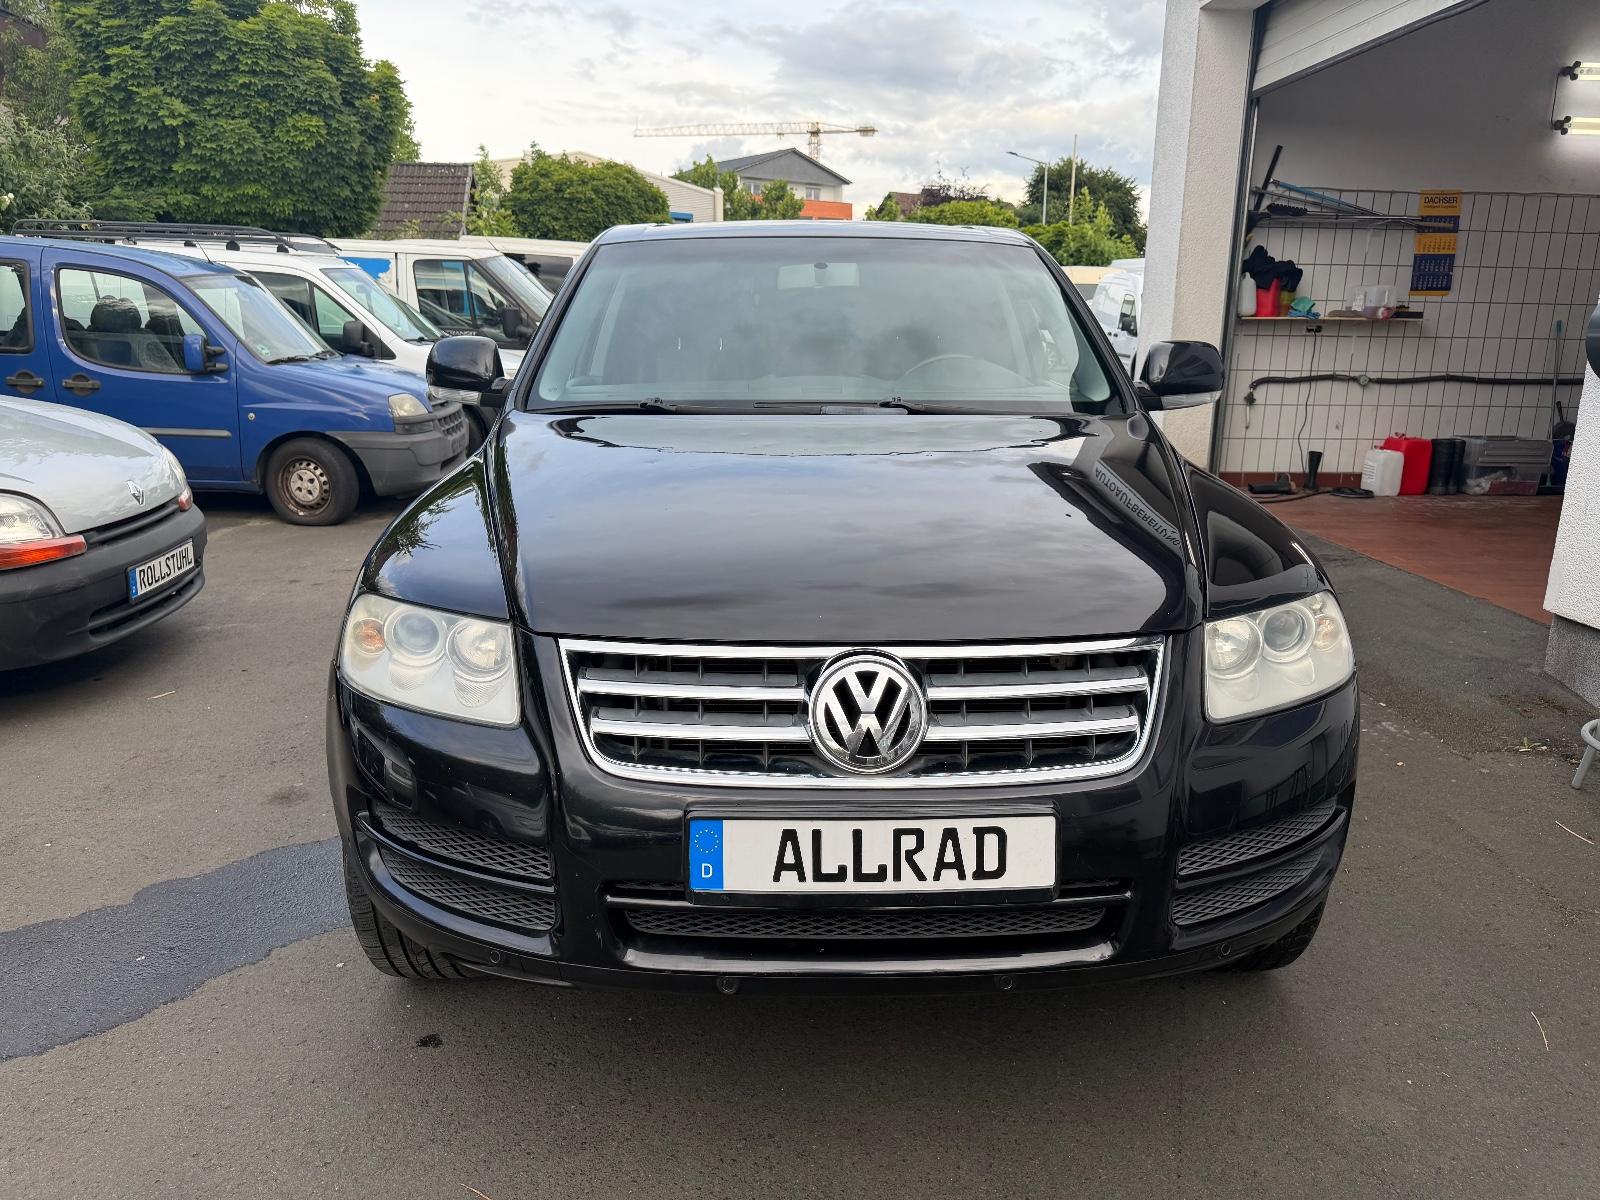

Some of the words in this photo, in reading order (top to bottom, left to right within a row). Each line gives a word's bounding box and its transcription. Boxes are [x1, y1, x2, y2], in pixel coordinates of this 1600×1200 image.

[1424, 197, 1457, 205] DACHSER
[139, 547, 192, 590] ROLLSTUHL
[814, 658, 922, 770] VW
[701, 863, 713, 878] D
[772, 827, 1008, 882] ALLRAD
